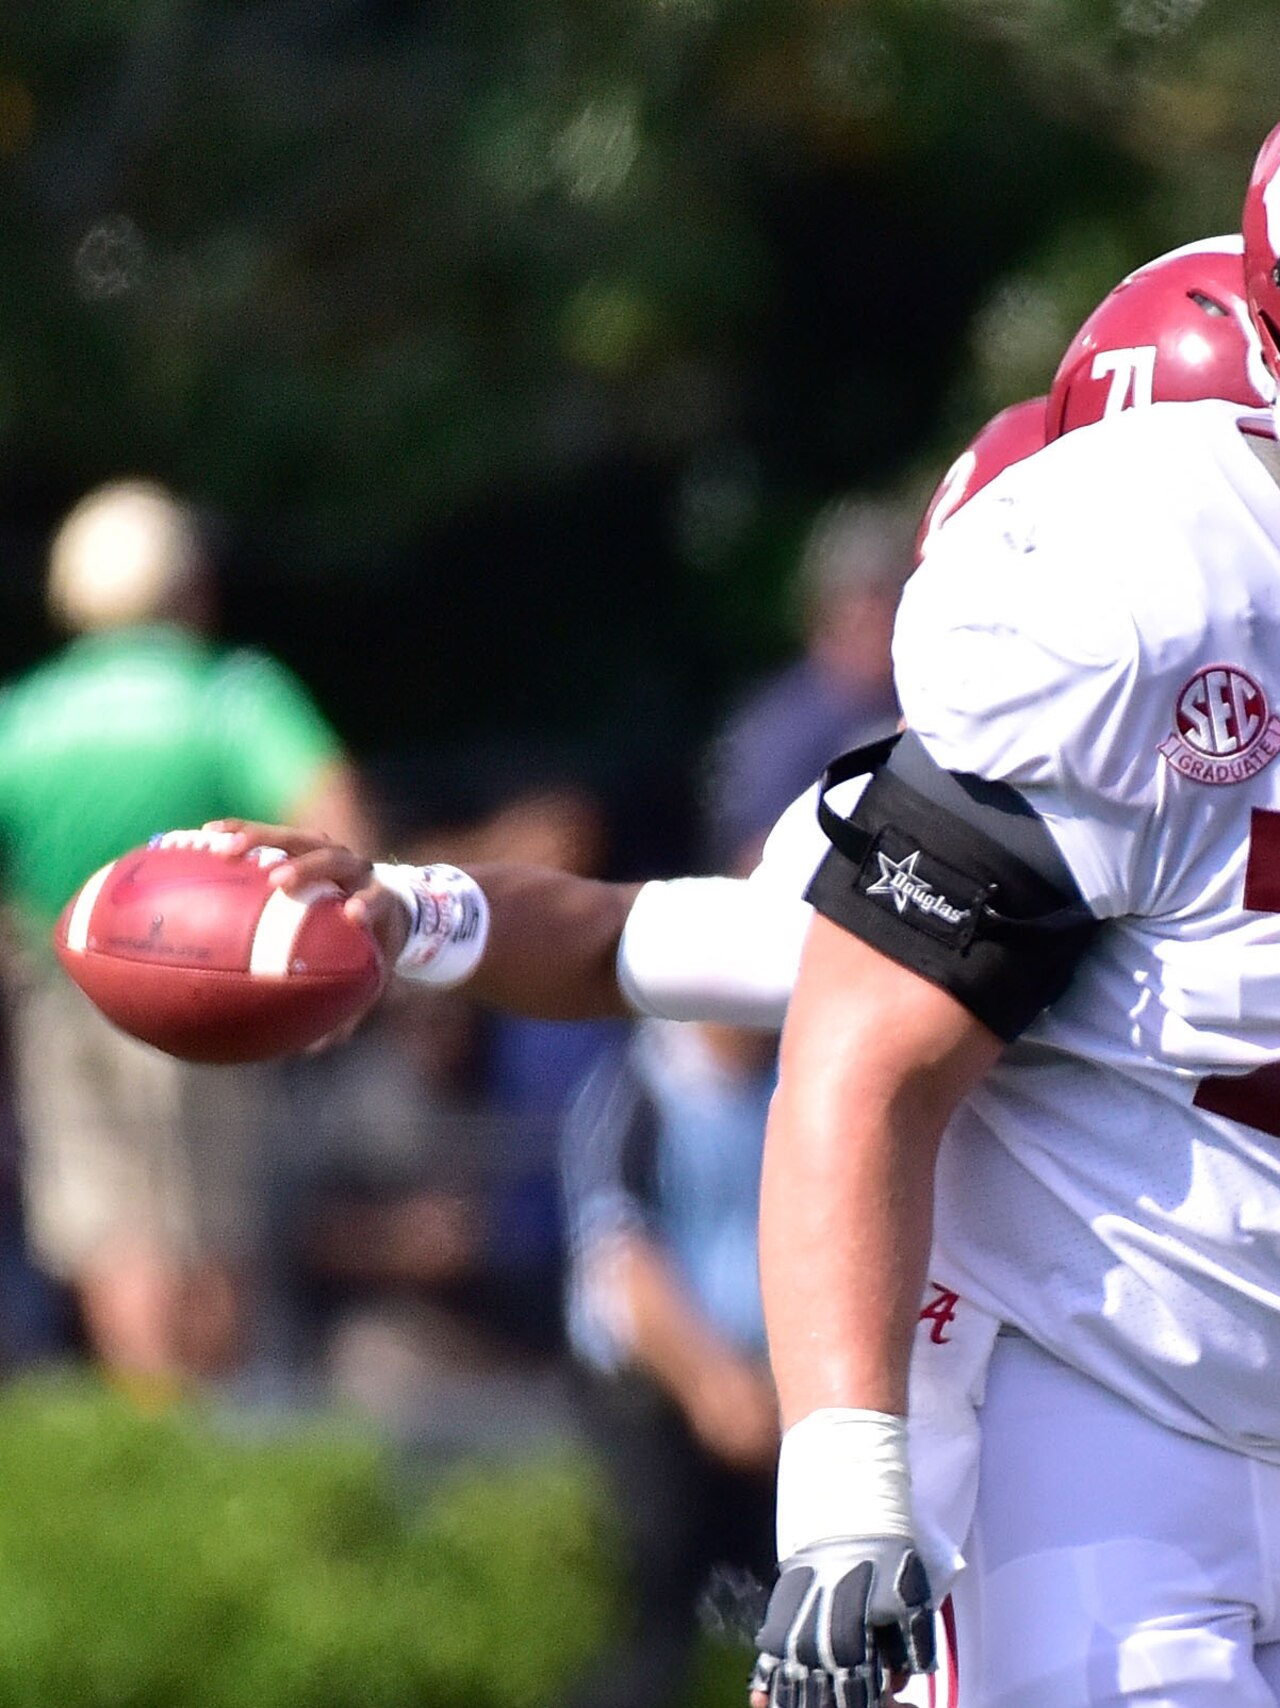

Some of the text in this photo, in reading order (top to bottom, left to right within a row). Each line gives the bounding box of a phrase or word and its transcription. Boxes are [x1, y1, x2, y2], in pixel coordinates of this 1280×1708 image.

[1091, 345, 1157, 419] 71
[1181, 671, 1260, 752] SEC
[1178, 740, 1276, 782] GRADUATE
[889, 870, 964, 925] Douglas
